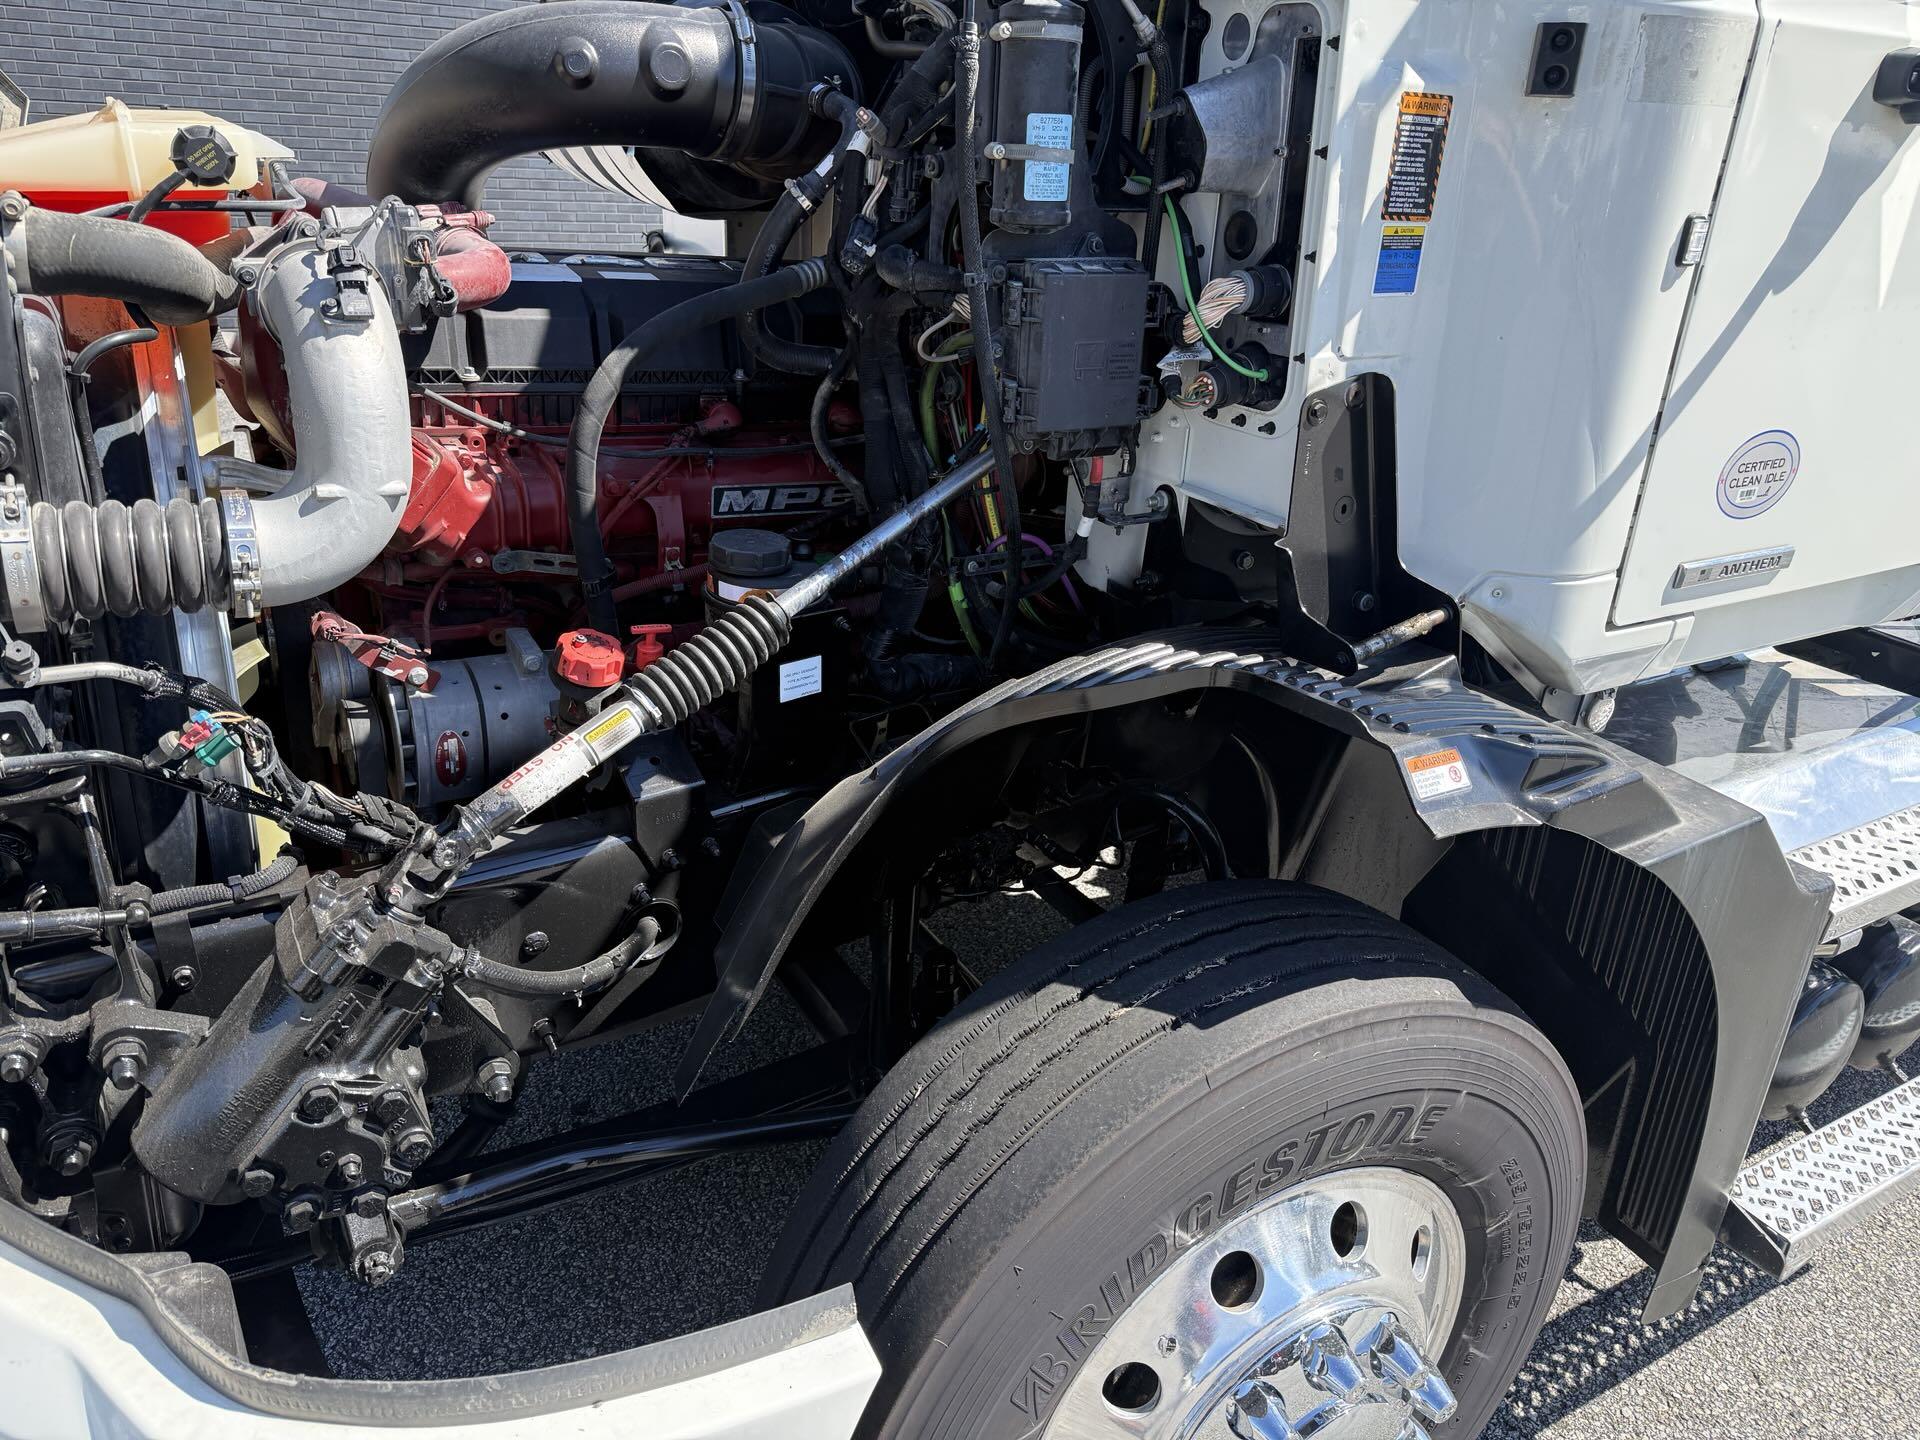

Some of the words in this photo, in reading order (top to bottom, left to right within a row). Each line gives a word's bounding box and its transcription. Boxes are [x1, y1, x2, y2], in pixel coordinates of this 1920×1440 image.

[1412, 100, 1447, 112] WARNING
[187, 155, 195, 163] DO
[194, 149, 203, 159] NOT
[202, 142, 215, 153] OPEN
[195, 156, 208, 167] WHEN
[207, 150, 217, 160] HOT
[1737, 457, 1786, 473] CERTIFIED
[1729, 475, 1762, 489] CLEAN
[1764, 471, 1787, 483] IDLE
[1718, 555, 1783, 578] ANTHEM
[551, 735, 574, 752] NO
[1420, 752, 1456, 768] WARNING
[500, 758, 544, 791] STEP
[1499, 1157, 1533, 1310] 295/75R22.5
[1010, 1102, 1451, 1424] BRIDGESTONE
